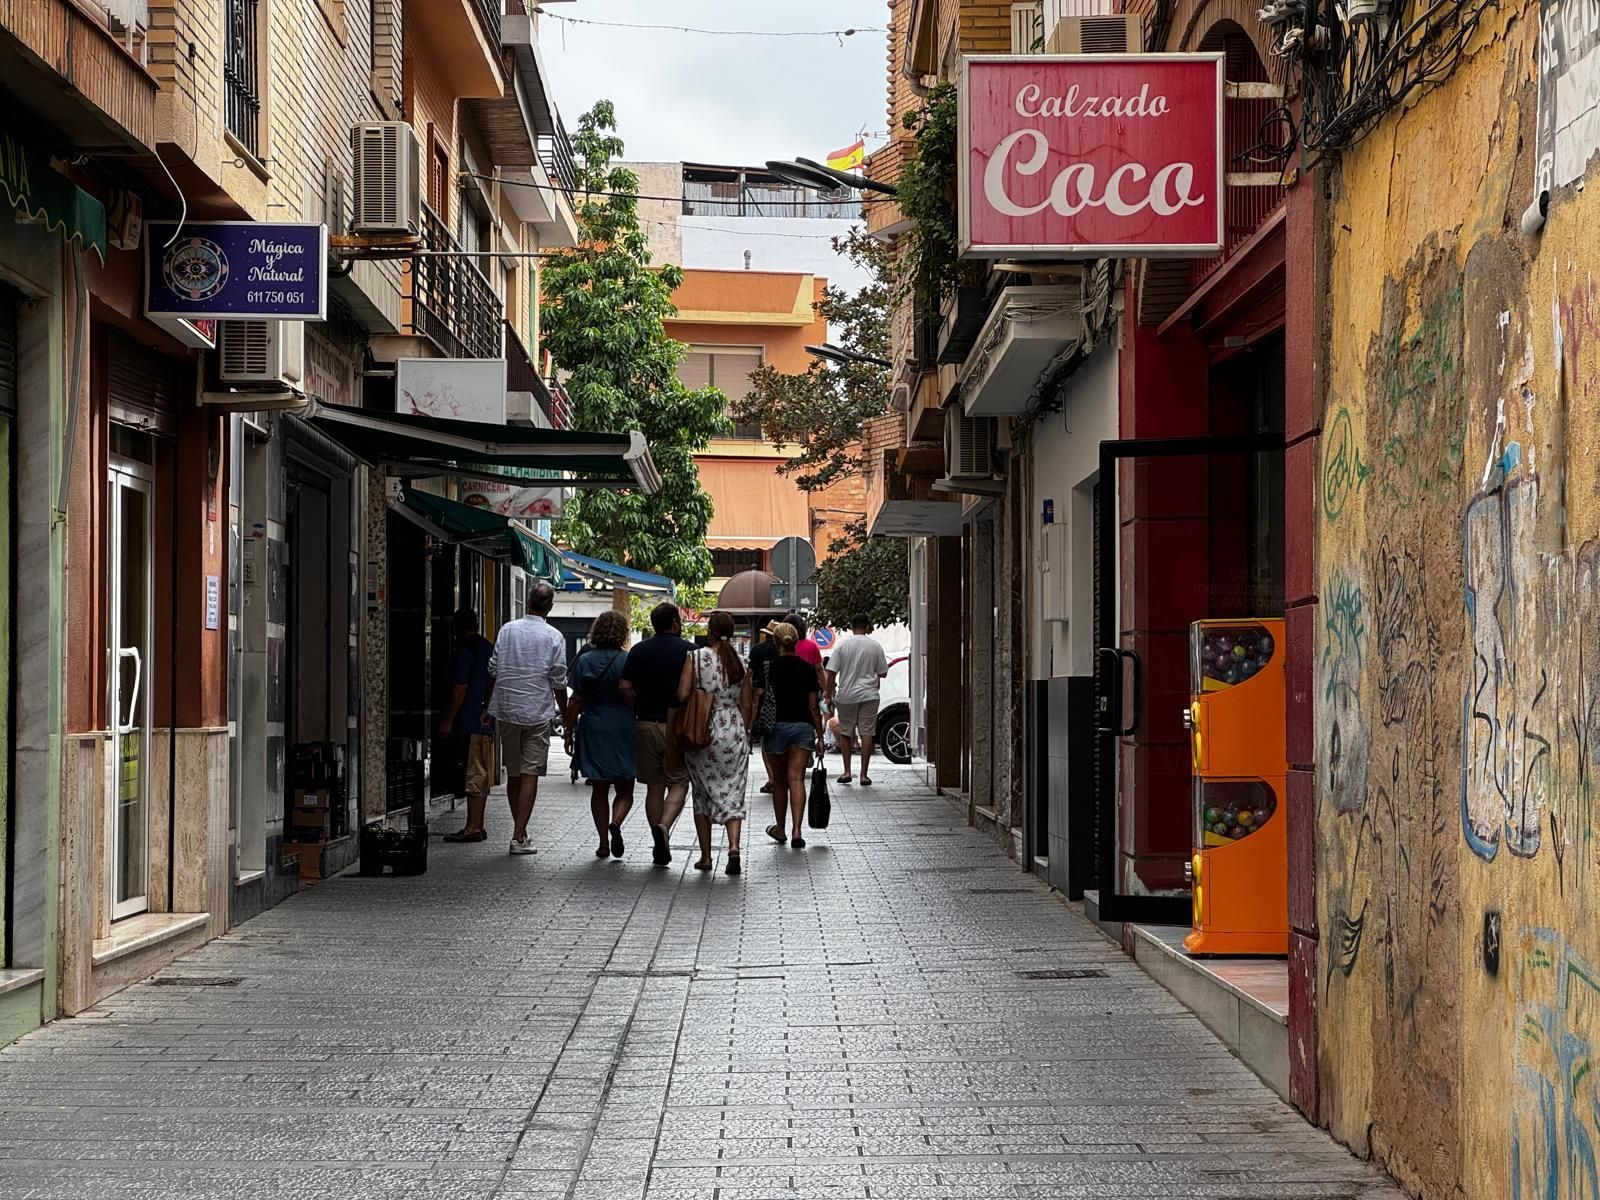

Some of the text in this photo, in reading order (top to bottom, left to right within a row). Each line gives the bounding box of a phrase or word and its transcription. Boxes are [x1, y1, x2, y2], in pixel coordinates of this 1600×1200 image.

[1015, 83, 1170, 118] Calzado
[984, 128, 1205, 217] Coco
[248, 239, 305, 260] Mágica
[265, 255, 276, 270] y
[247, 266, 304, 282] Natural
[247, 290, 304, 304] 611 750 051
